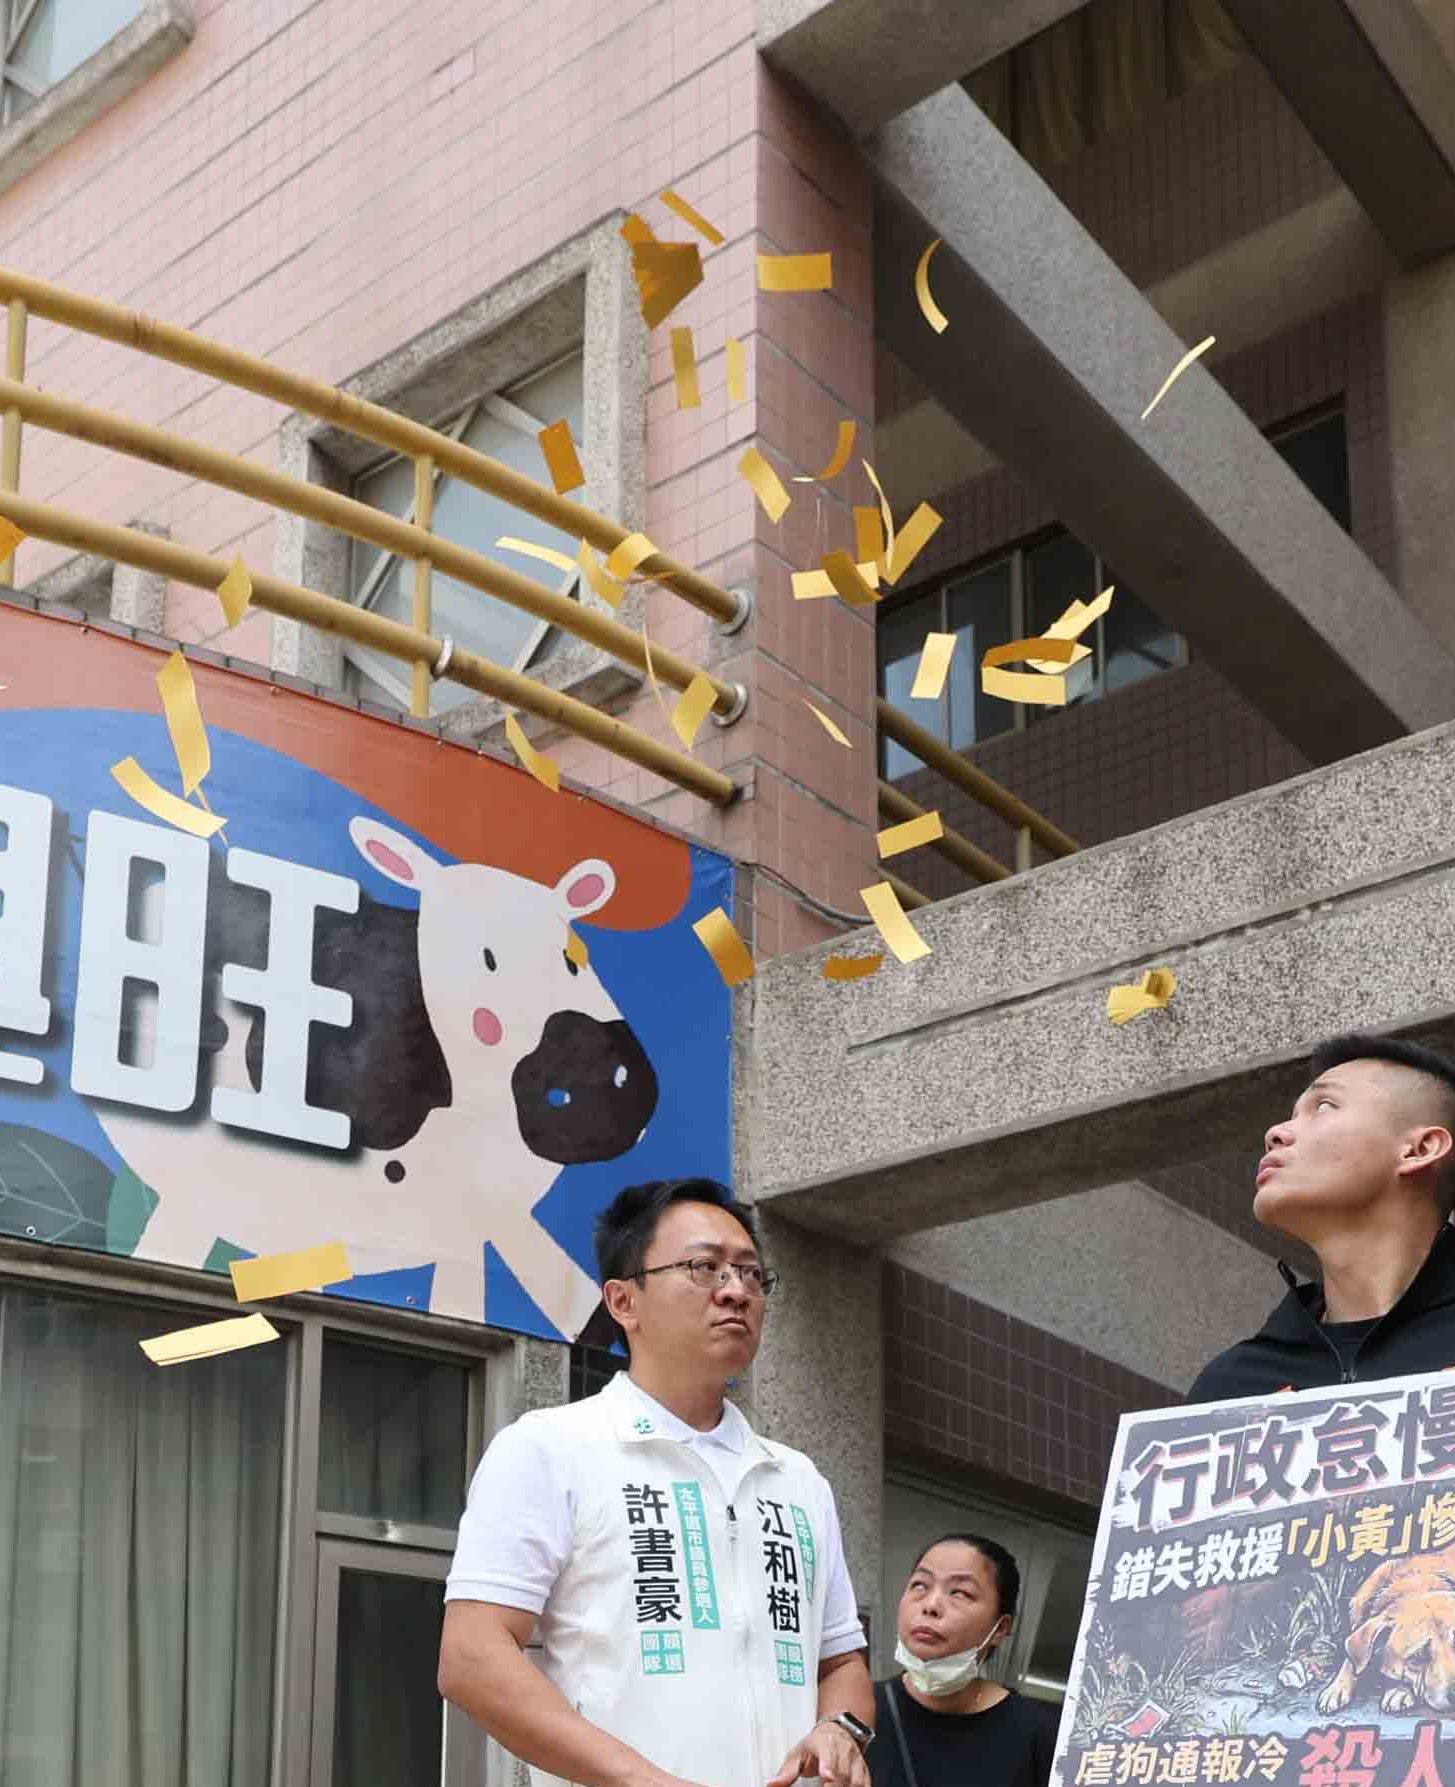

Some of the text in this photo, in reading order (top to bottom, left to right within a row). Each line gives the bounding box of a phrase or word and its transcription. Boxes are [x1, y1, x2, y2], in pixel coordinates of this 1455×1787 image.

[622, 1483, 682, 1622] 許書豪
[757, 1498, 800, 1633] 江和樹
